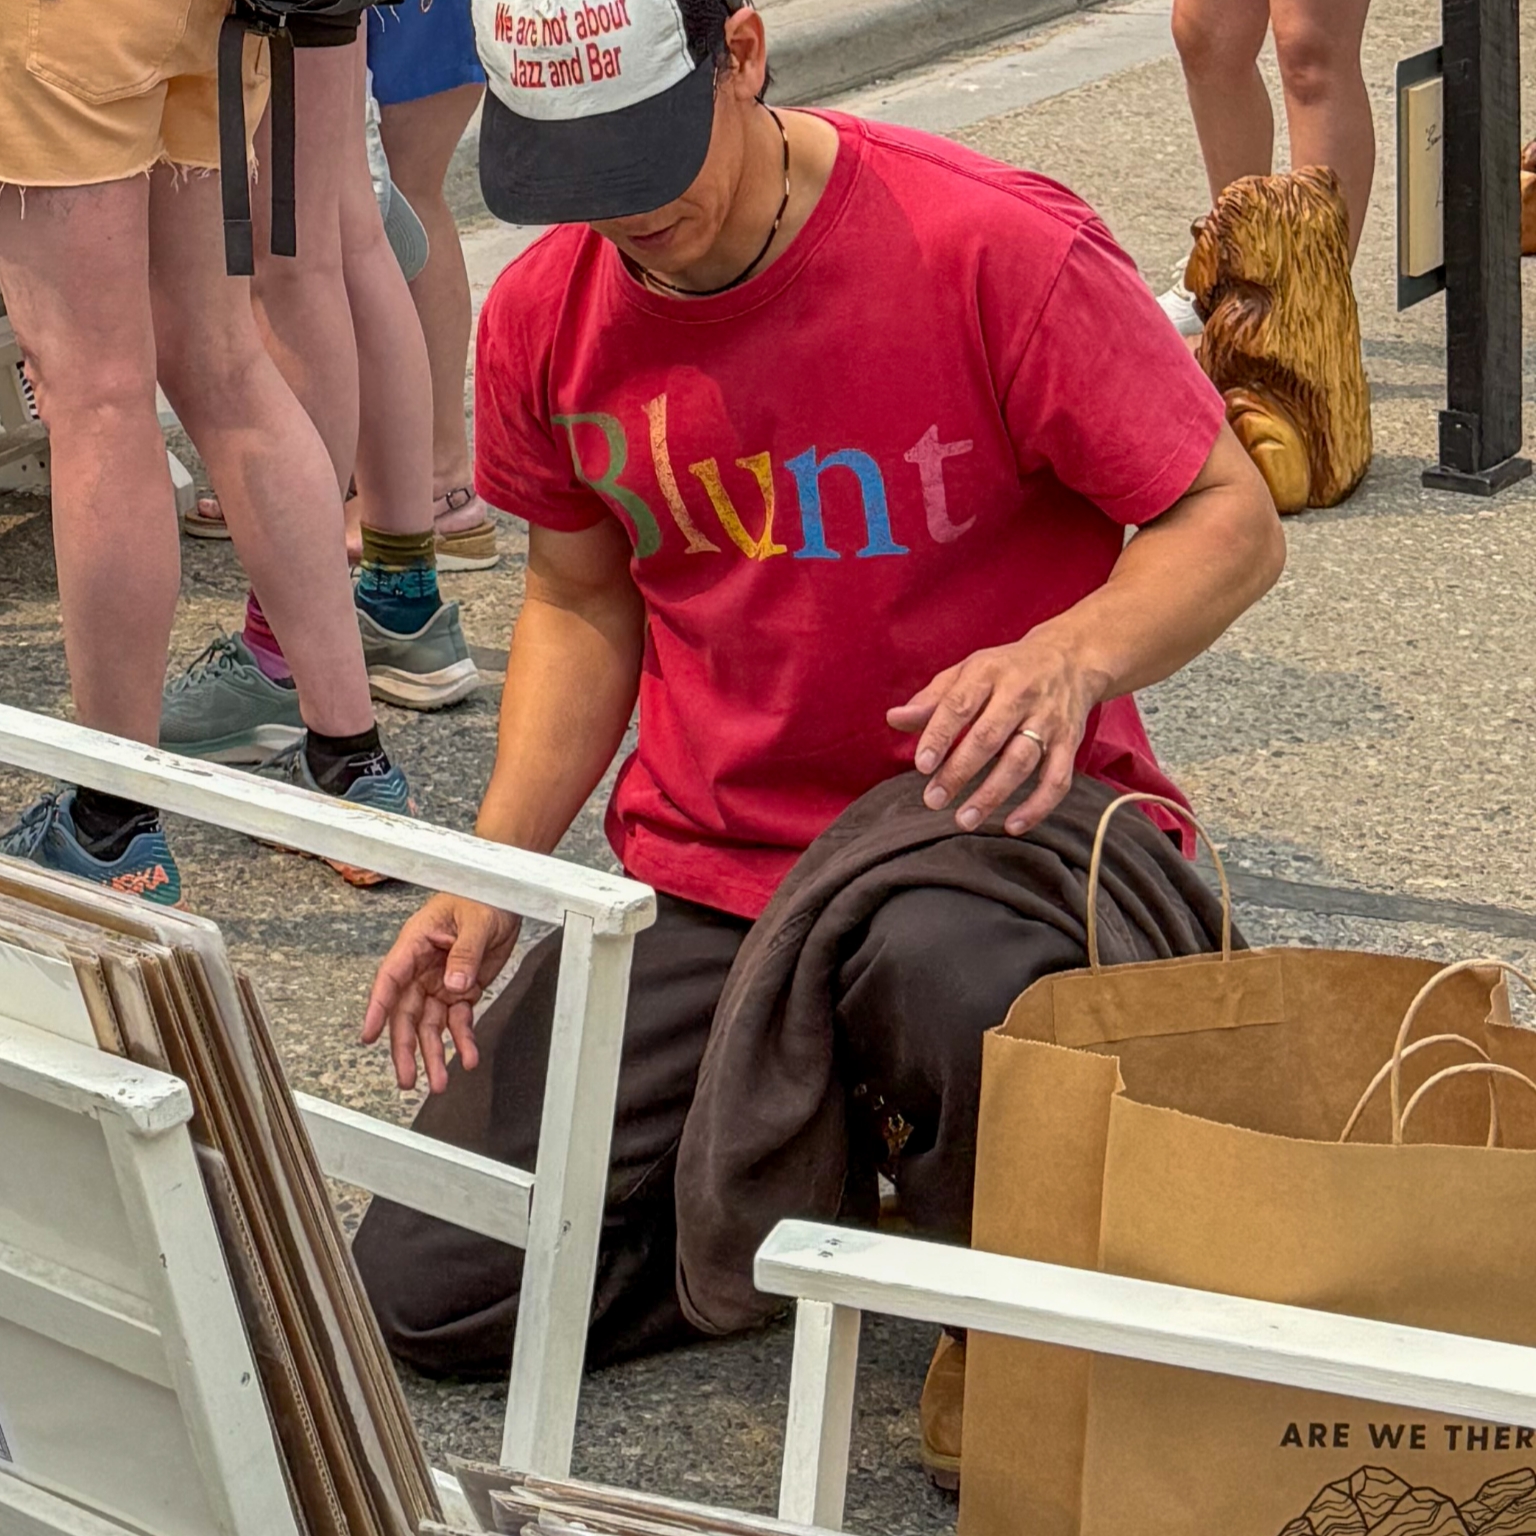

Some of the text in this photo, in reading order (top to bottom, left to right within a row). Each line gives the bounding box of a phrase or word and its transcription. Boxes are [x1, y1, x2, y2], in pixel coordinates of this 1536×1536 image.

[495, 2, 512, 43] We
[516, 16, 537, 47] are
[541, 6, 572, 47] not
[510, 43, 621, 87] Jazz and Bar
[1280, 1423, 1535, 1451] ARE WE THER
